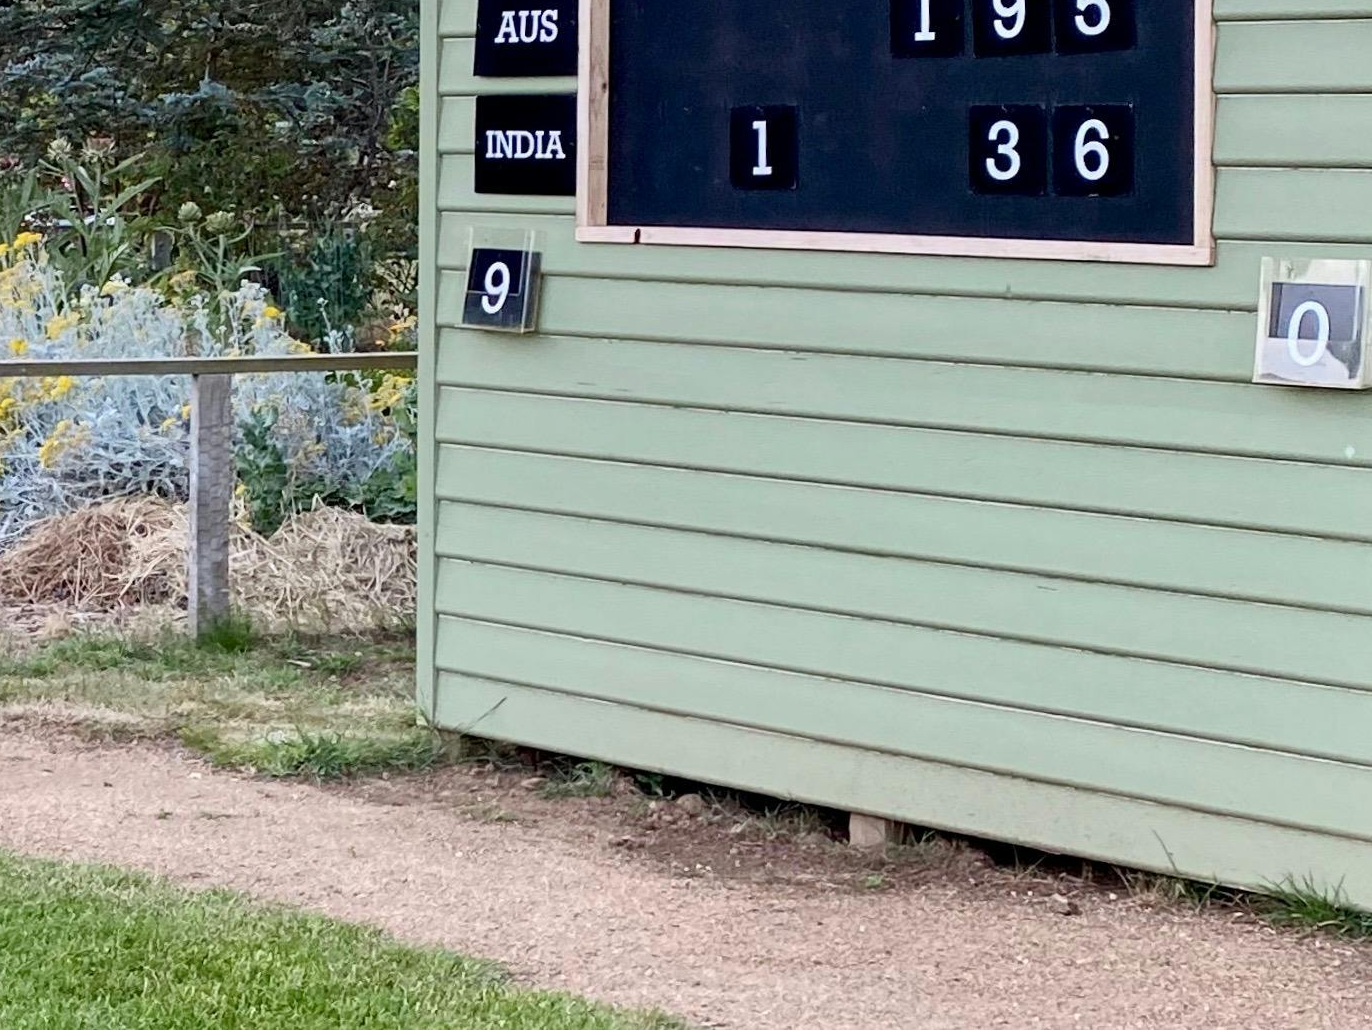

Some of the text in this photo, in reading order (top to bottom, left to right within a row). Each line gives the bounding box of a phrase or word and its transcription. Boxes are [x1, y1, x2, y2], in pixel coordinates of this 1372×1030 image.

[494, 9, 558, 44] AUS
[485, 130, 566, 159] INDIA
[751, 120, 772, 176] 1
[481, 261, 510, 314] 9
[1287, 300, 1331, 367] 0
